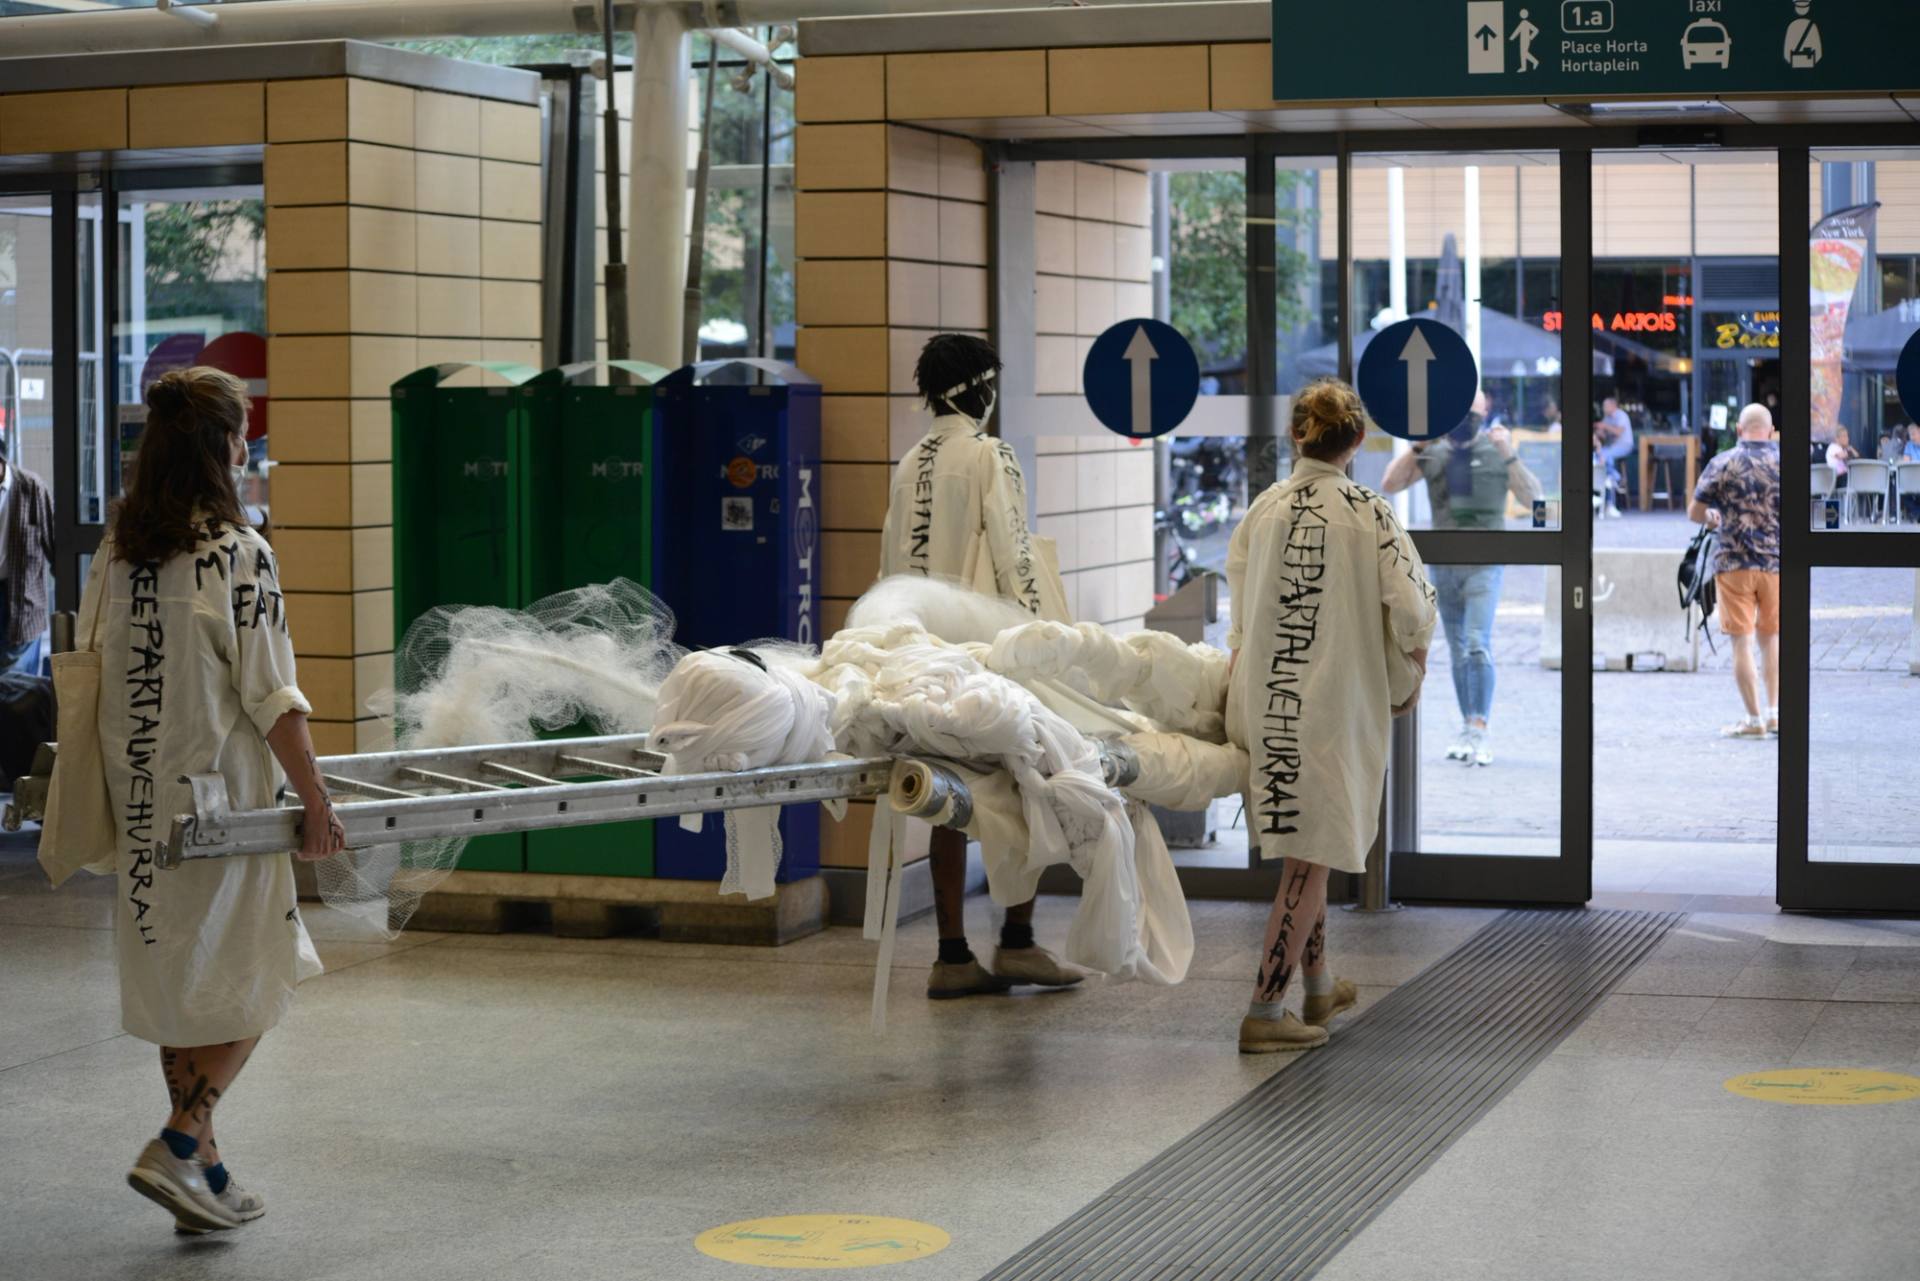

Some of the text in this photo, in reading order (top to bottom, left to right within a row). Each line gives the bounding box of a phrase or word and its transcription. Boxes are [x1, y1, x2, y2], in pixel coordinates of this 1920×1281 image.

[1571, 6, 1603, 26] 1.a
[1561, 39, 1648, 54] Place Horta
[1561, 57, 1640, 75] Hortaplein
[1611, 311, 1677, 332] ARTOIS
